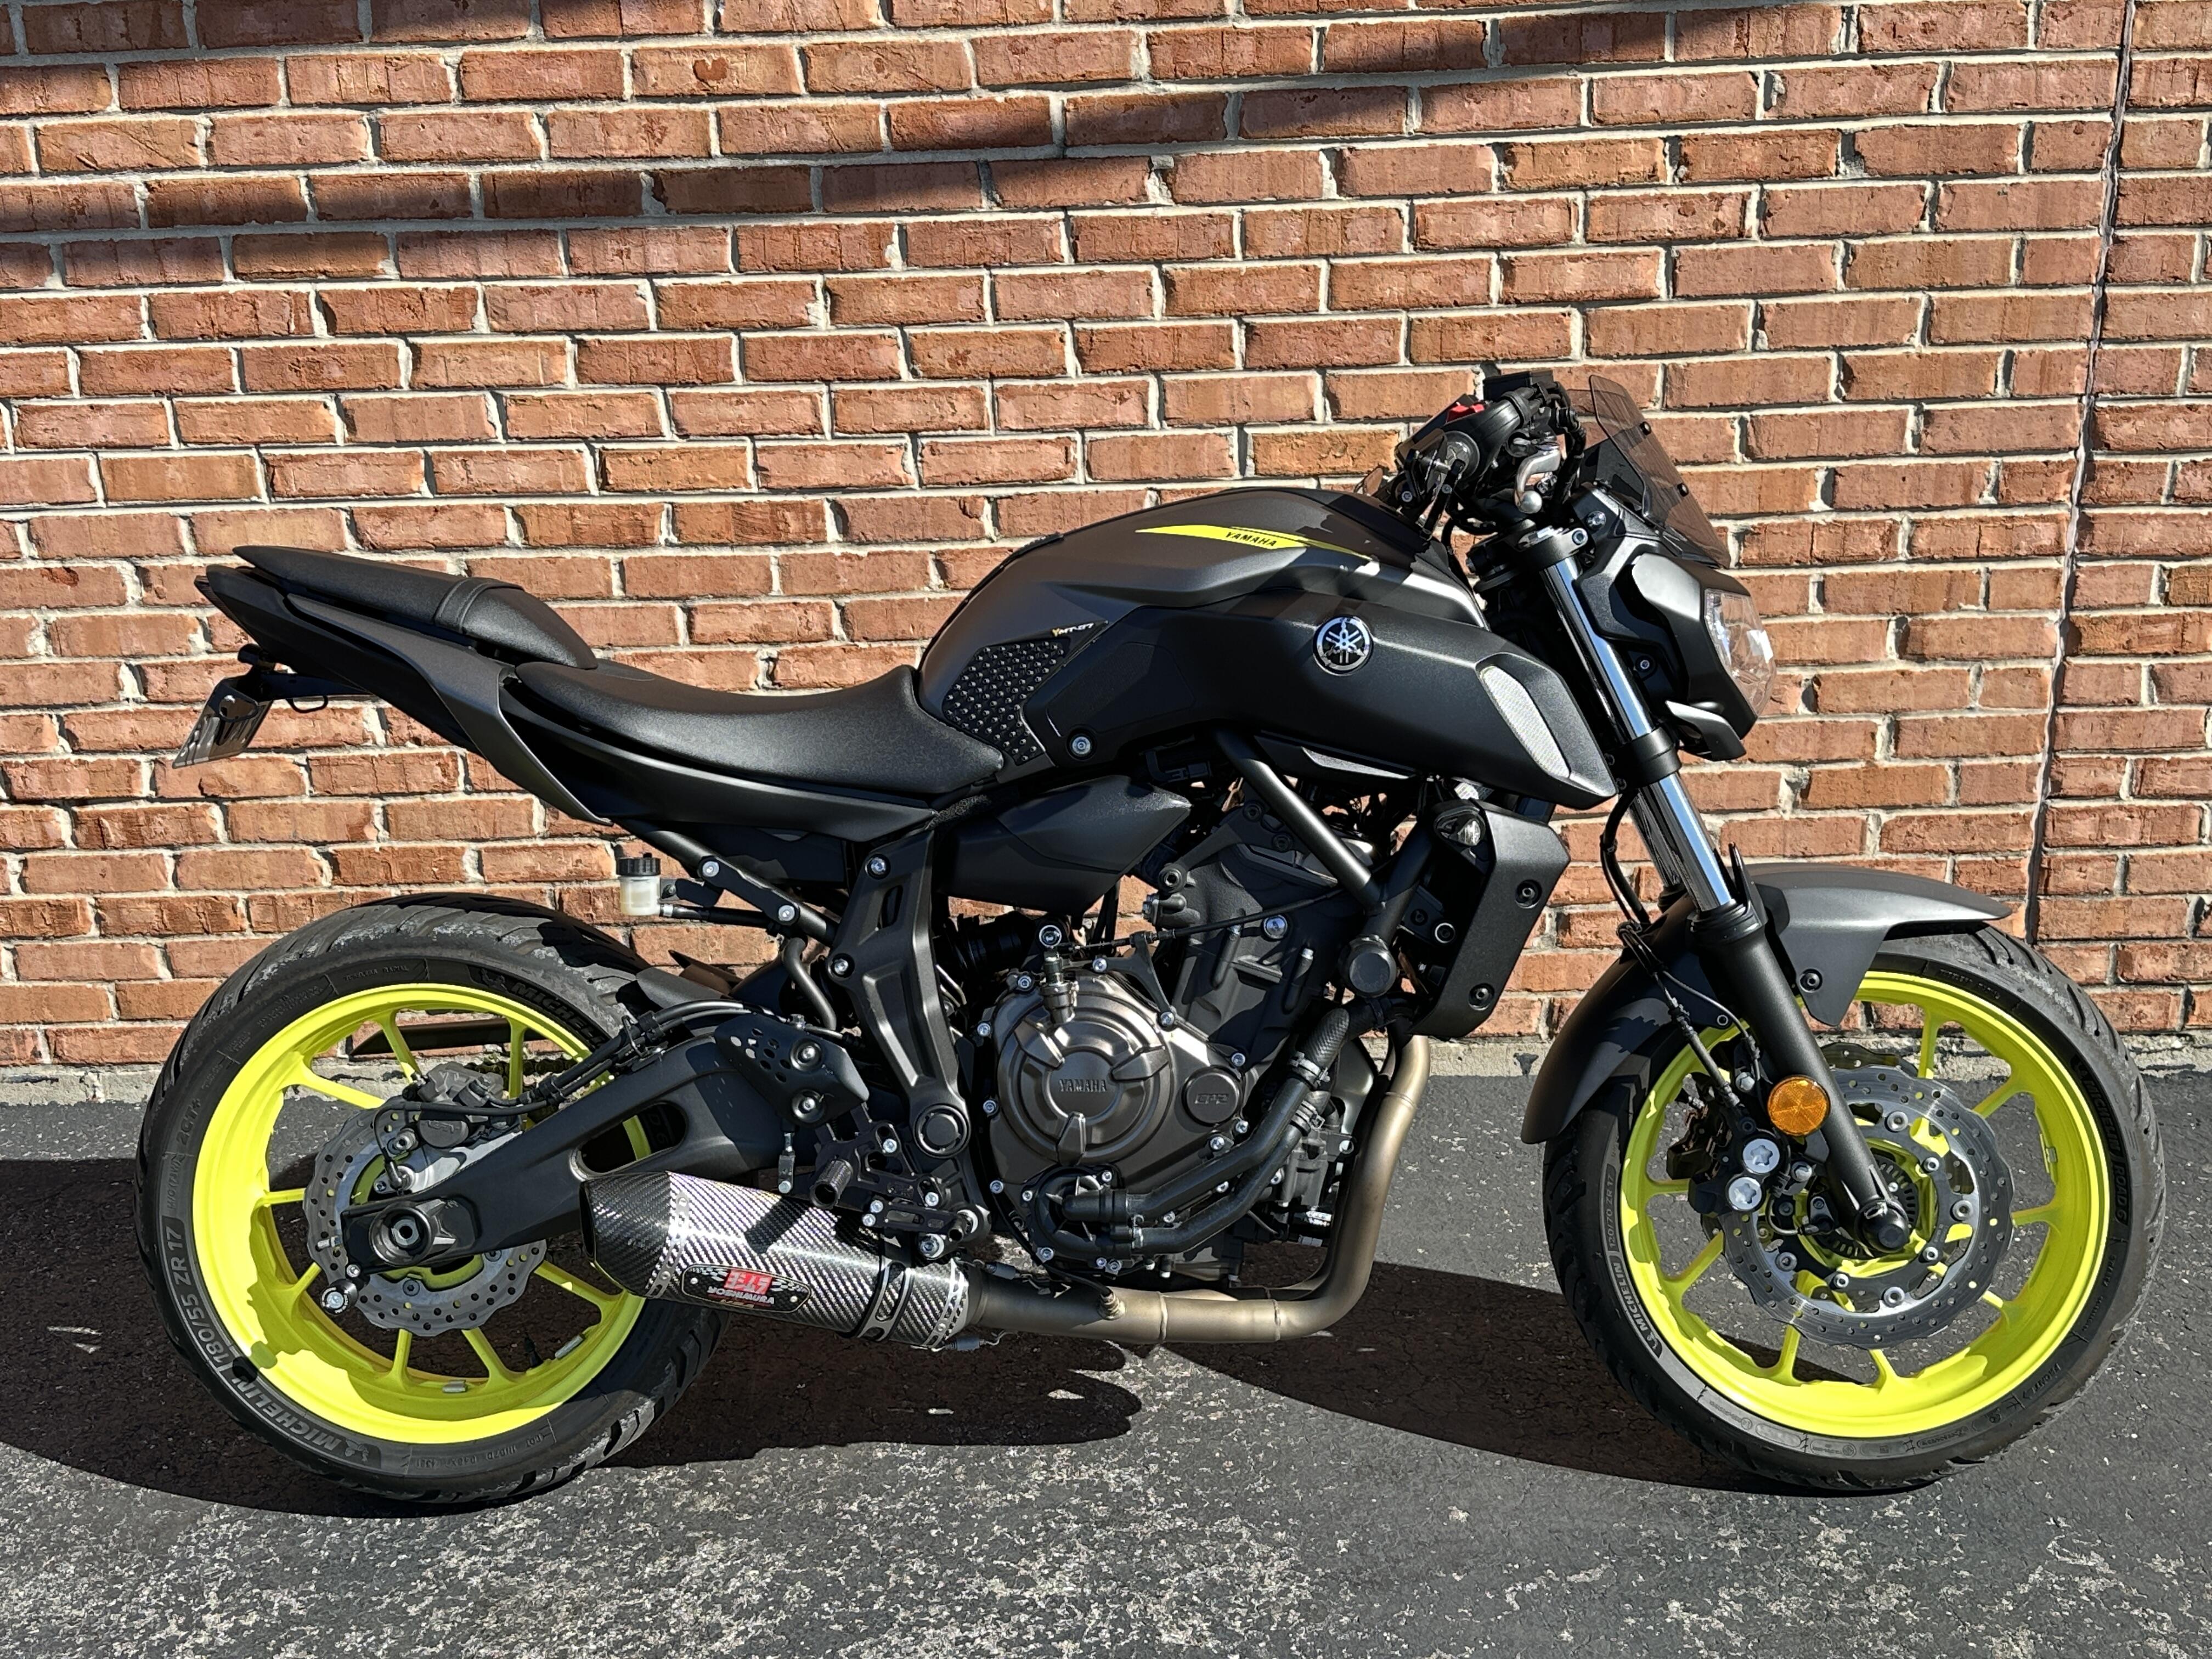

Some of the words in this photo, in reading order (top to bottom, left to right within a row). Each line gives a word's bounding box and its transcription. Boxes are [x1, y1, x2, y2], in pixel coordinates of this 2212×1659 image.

[1225, 532, 1277, 547] YAMAHA
[511, 981, 606, 1049] MICHELI
[1059, 1079, 1107, 1093] YAMAHA
[176, 1098, 202, 1146] 2CT+
[2085, 1080, 2122, 1154] MICHELIN
[1605, 1189, 1613, 1204] ZR
[1606, 1175, 1615, 1187] 17
[2115, 1167, 2127, 1204] ROAD
[1605, 1207, 1617, 1249] 120/70
[2115, 1207, 2127, 1220] 6
[166, 1228, 183, 1250] 17
[170, 1257, 191, 1287] ZR
[1612, 1262, 1649, 1332] MICHELIN
[181, 1291, 229, 1368] 180/55
[232, 1376, 341, 1453] MICHELIN
